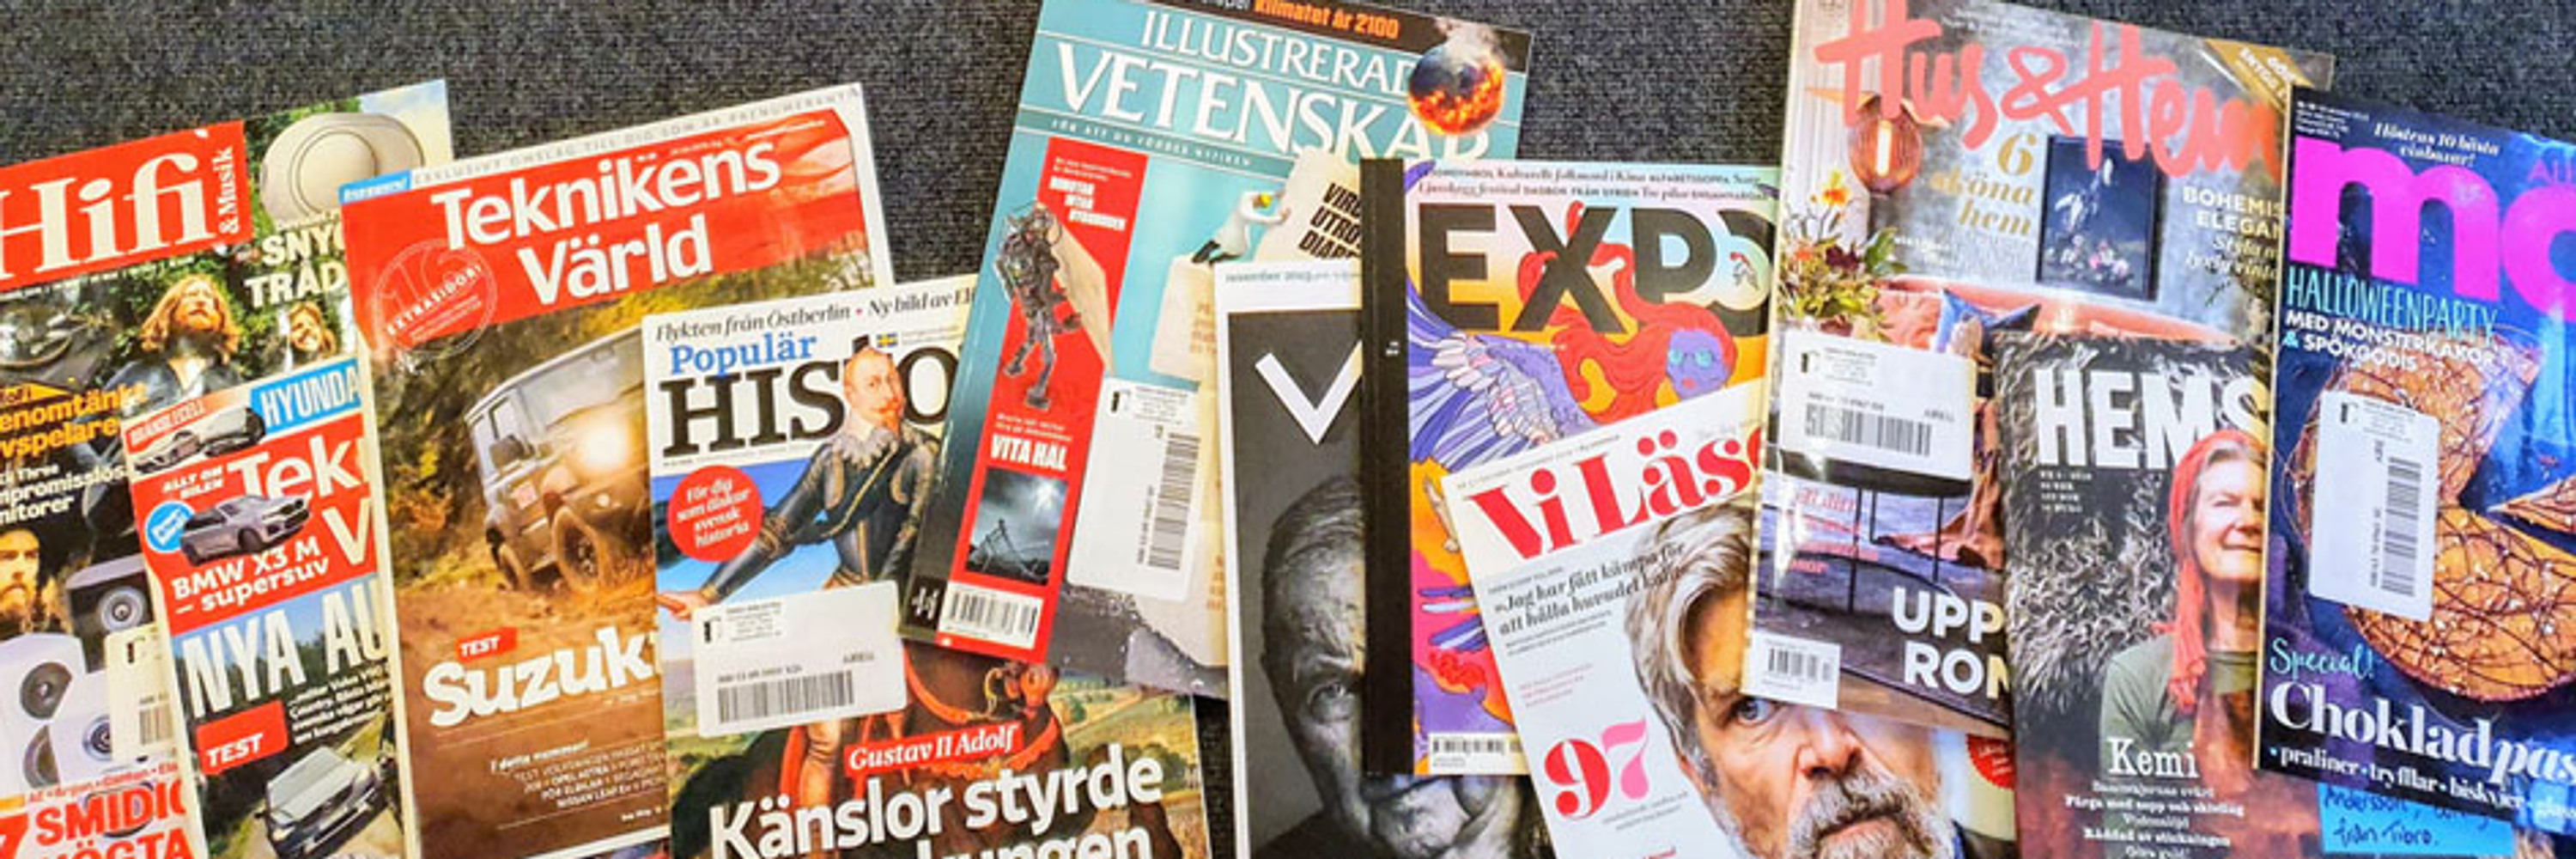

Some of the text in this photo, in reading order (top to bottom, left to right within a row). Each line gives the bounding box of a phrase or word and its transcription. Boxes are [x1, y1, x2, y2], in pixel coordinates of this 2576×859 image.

[1354, 13, 1400, 40] 2100
[213, 145, 241, 216] Musik
[1996, 133, 2038, 177] 6
[430, 141, 782, 251] Teknikens
[1929, 163, 2034, 206] sköna
[0, 152, 216, 282] Hifi
[1309, 205, 1360, 248] UTRO
[1959, 199, 2032, 237] hem
[517, 212, 714, 307] Värld
[1419, 200, 1776, 338] EXPO
[655, 317, 723, 344] Flykten
[724, 311, 766, 337] från
[767, 300, 852, 328] Östberlin
[867, 297, 893, 319] Ny
[893, 291, 927, 313] bild
[928, 293, 951, 309] av
[2285, 310, 2328, 332] MED
[2287, 266, 2499, 346] HALLOWEENPARTY
[669, 332, 817, 379] Populär
[2281, 330, 2419, 370] & SPÖKGODIS
[258, 365, 361, 429] HYUNDA
[1255, 338, 1363, 445] V
[228, 435, 363, 502] Tek
[991, 434, 1067, 472] VITA HÅL
[1464, 466, 1582, 561] Vi
[171, 536, 321, 600] BMW X3 M
[200, 557, 330, 613] supersuv
[1536, 579, 1569, 602] har
[1498, 616, 1523, 637] att
[1526, 603, 1571, 631] hålla
[1571, 581, 1641, 615] huvudet
[1892, 585, 2007, 643] UPP
[182, 608, 307, 720] NYA
[459, 635, 501, 657] TEST
[2269, 637, 2376, 682] Special!
[422, 624, 655, 727] Suzuk
[205, 731, 265, 767] TEST
[848, 722, 1020, 771] Gustav II Adolf
[1544, 716, 1651, 821] 97
[2106, 736, 2199, 778] Kemi
[2280, 745, 2360, 777] praliner
[708, 742, 1166, 859] Känslor styrde
